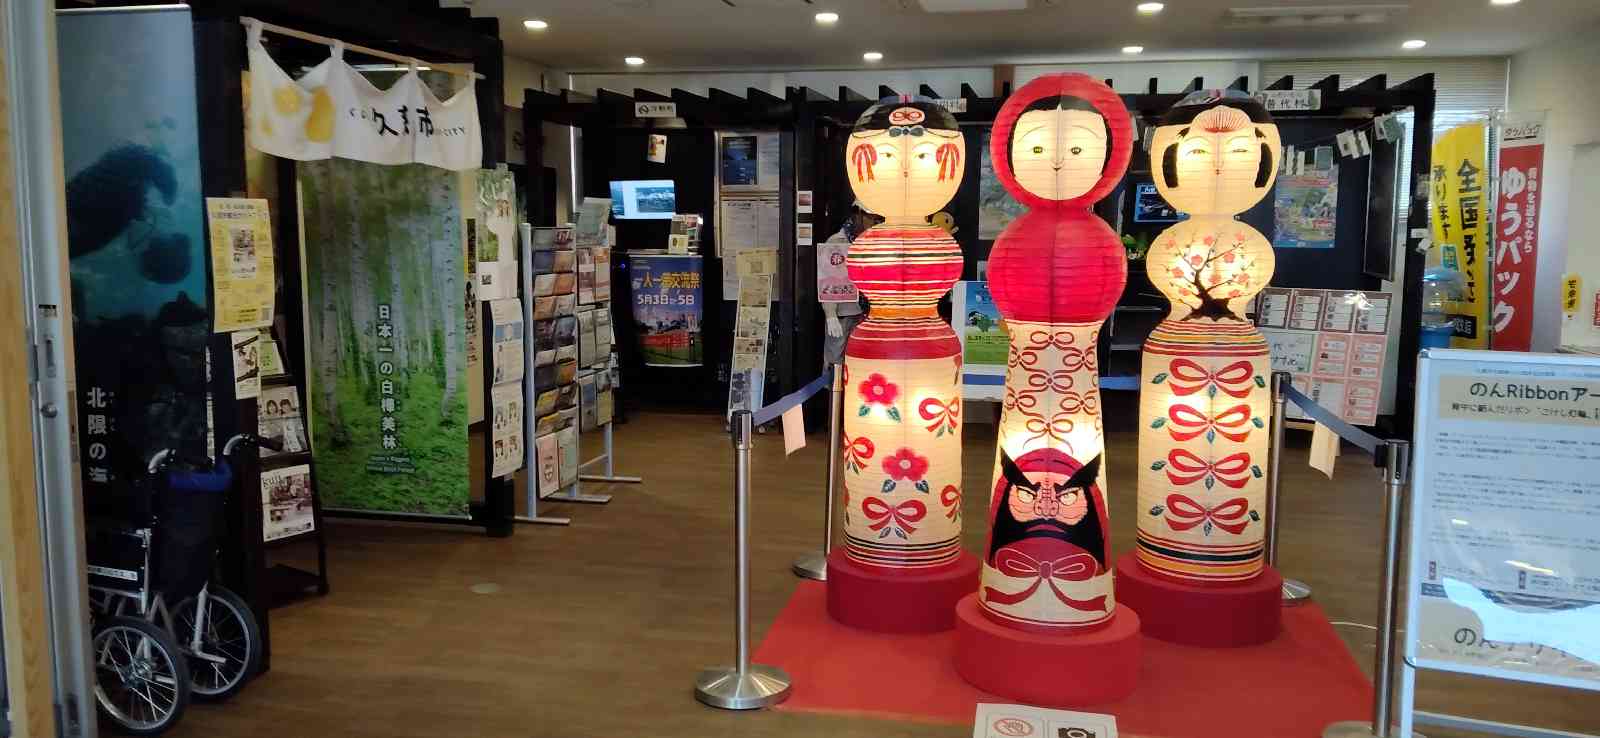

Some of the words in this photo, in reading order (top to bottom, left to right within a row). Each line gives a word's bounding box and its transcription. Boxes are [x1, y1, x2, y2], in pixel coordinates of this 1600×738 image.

[1495, 167, 1526, 333] ゆうパック
[378, 305, 397, 449] 日本一の白樺美林
